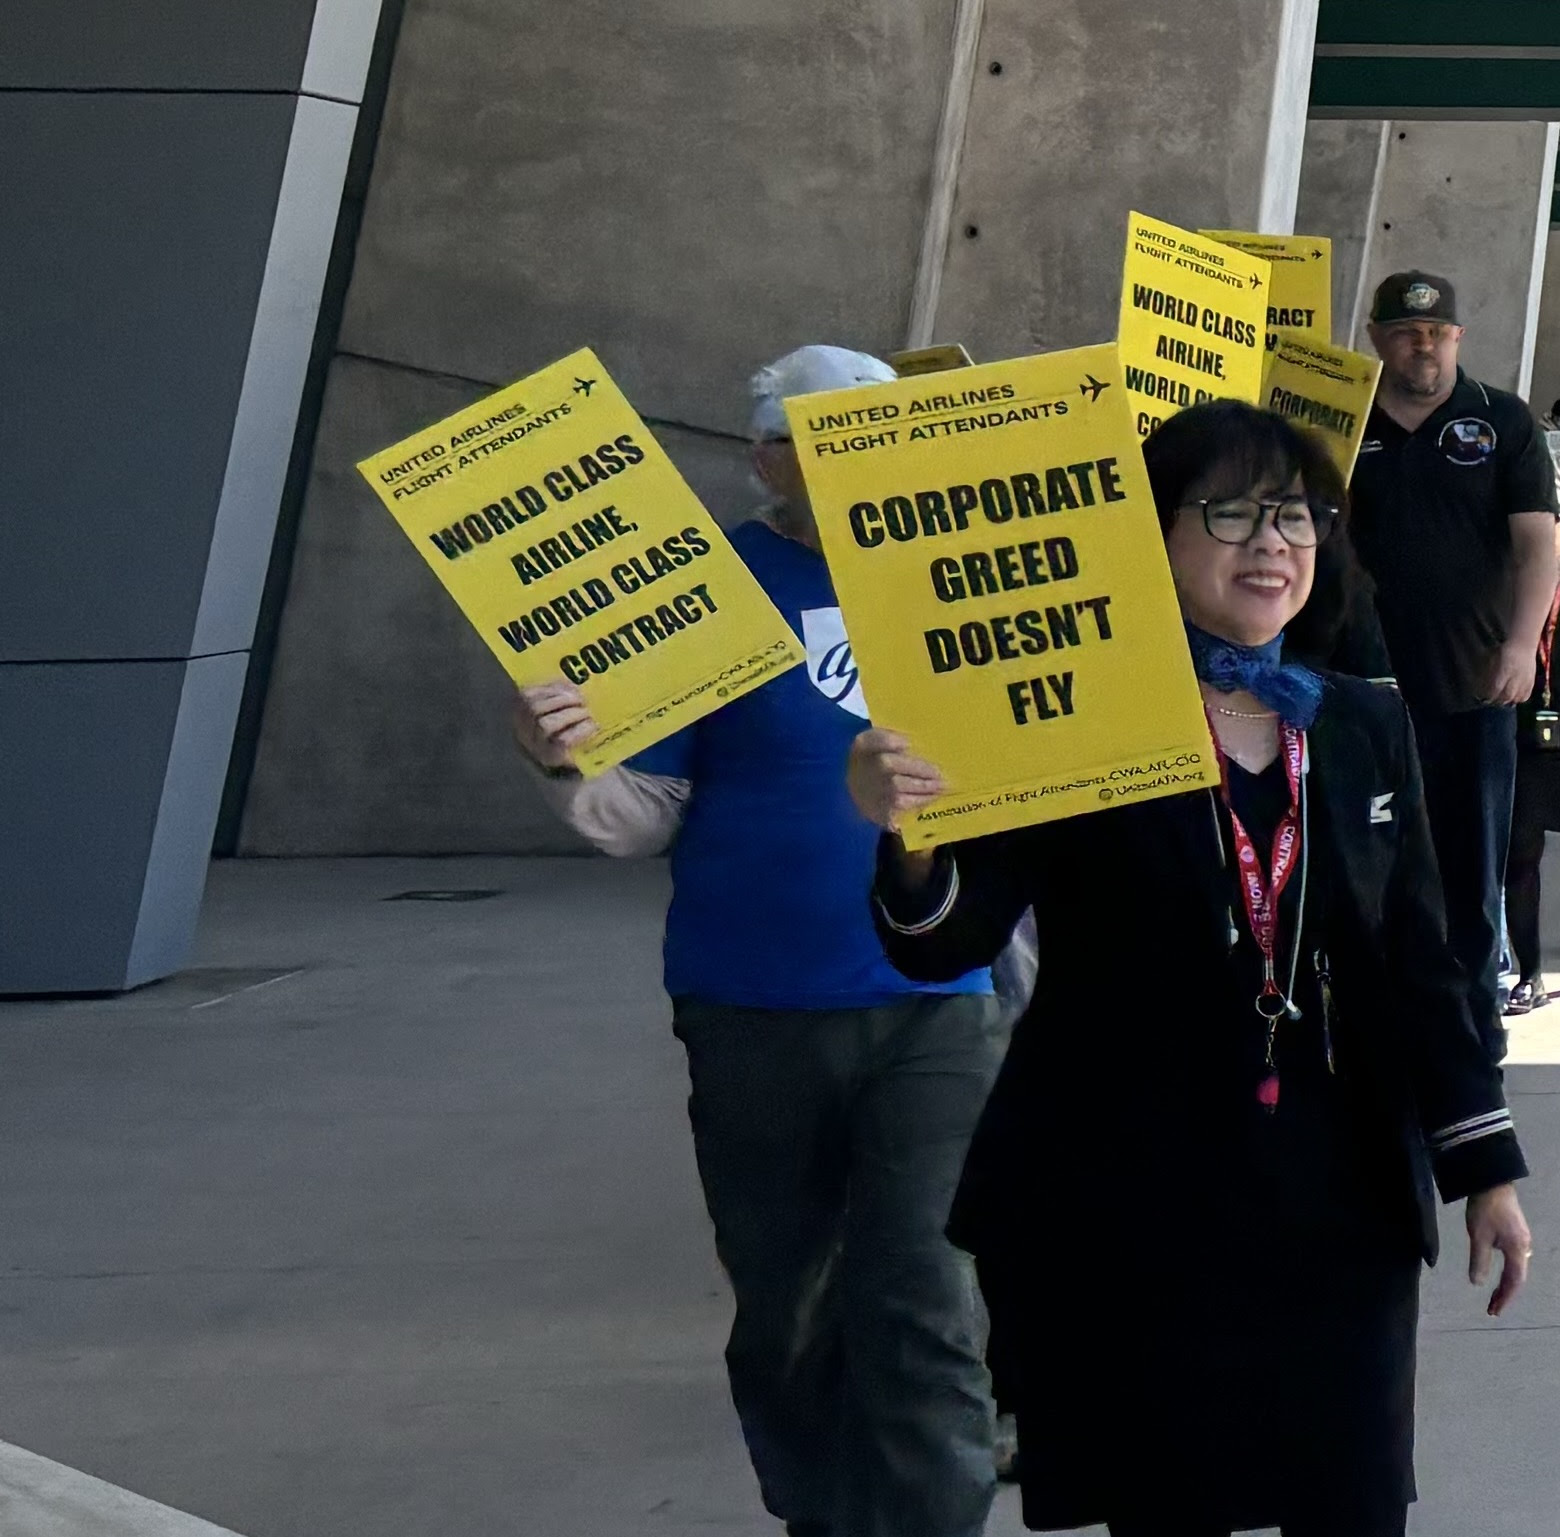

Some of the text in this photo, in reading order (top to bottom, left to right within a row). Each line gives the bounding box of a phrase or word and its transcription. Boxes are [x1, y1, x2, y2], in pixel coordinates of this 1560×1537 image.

[1135, 242, 1244, 289] FLIGHT ATTENDANTS
[1136, 227, 1177, 251] UNITED
[1178, 243, 1225, 267] AIRLINES
[1133, 283, 1198, 328] WORLD
[1201, 308, 1256, 348] CLASS
[1125, 365, 1190, 408] WORLD
[1156, 335, 1226, 381] AIRLINE,
[808, 384, 1015, 432] UNITED AIRLINES
[815, 400, 1069, 457] FLIGHT ATTENDANTS
[380, 403, 528, 484] UNITED AIRLINES
[393, 403, 571, 501] FLIGHT ATTENDANTS
[429, 434, 645, 560] WORLD CLASS
[848, 457, 1127, 548] CORPORATE
[510, 505, 639, 586] AIRLINE,
[930, 537, 1079, 604] GREED
[498, 526, 711, 653] WORLD CLASS
[559, 583, 719, 686] CONTRACT
[924, 596, 1112, 674] DOESN'T
[1007, 671, 1074, 726] FLY
